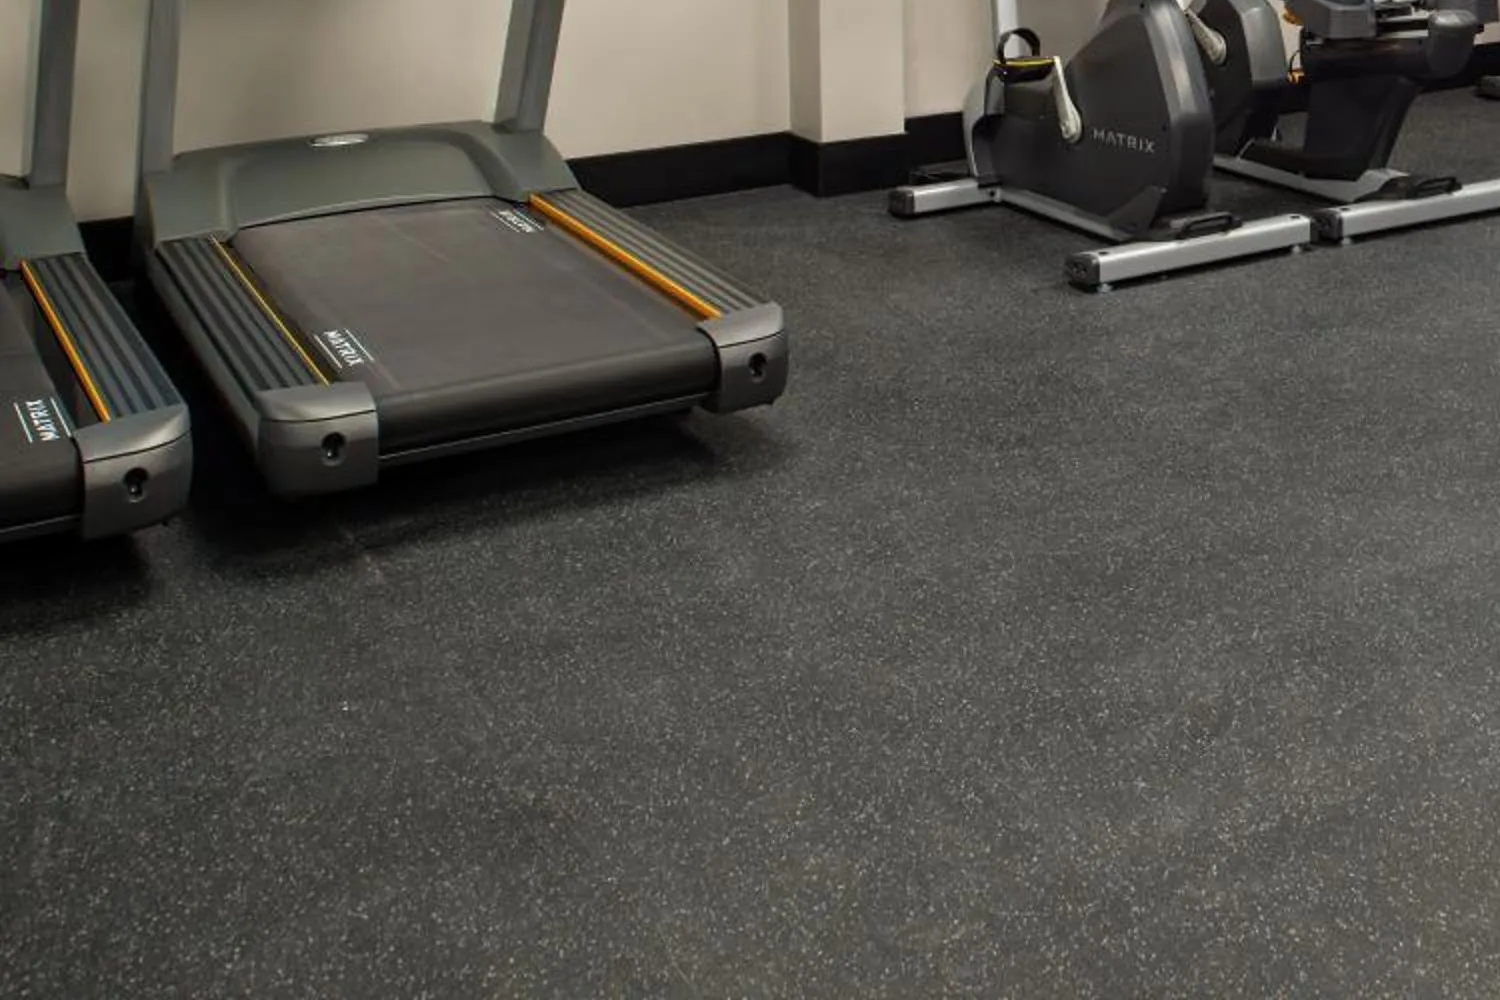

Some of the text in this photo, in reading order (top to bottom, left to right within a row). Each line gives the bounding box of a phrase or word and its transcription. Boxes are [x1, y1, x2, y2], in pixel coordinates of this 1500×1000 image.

[1092, 127, 1155, 153] MATRIX
[323, 329, 365, 367] MATRIX
[25, 399, 61, 441] MATRIX
